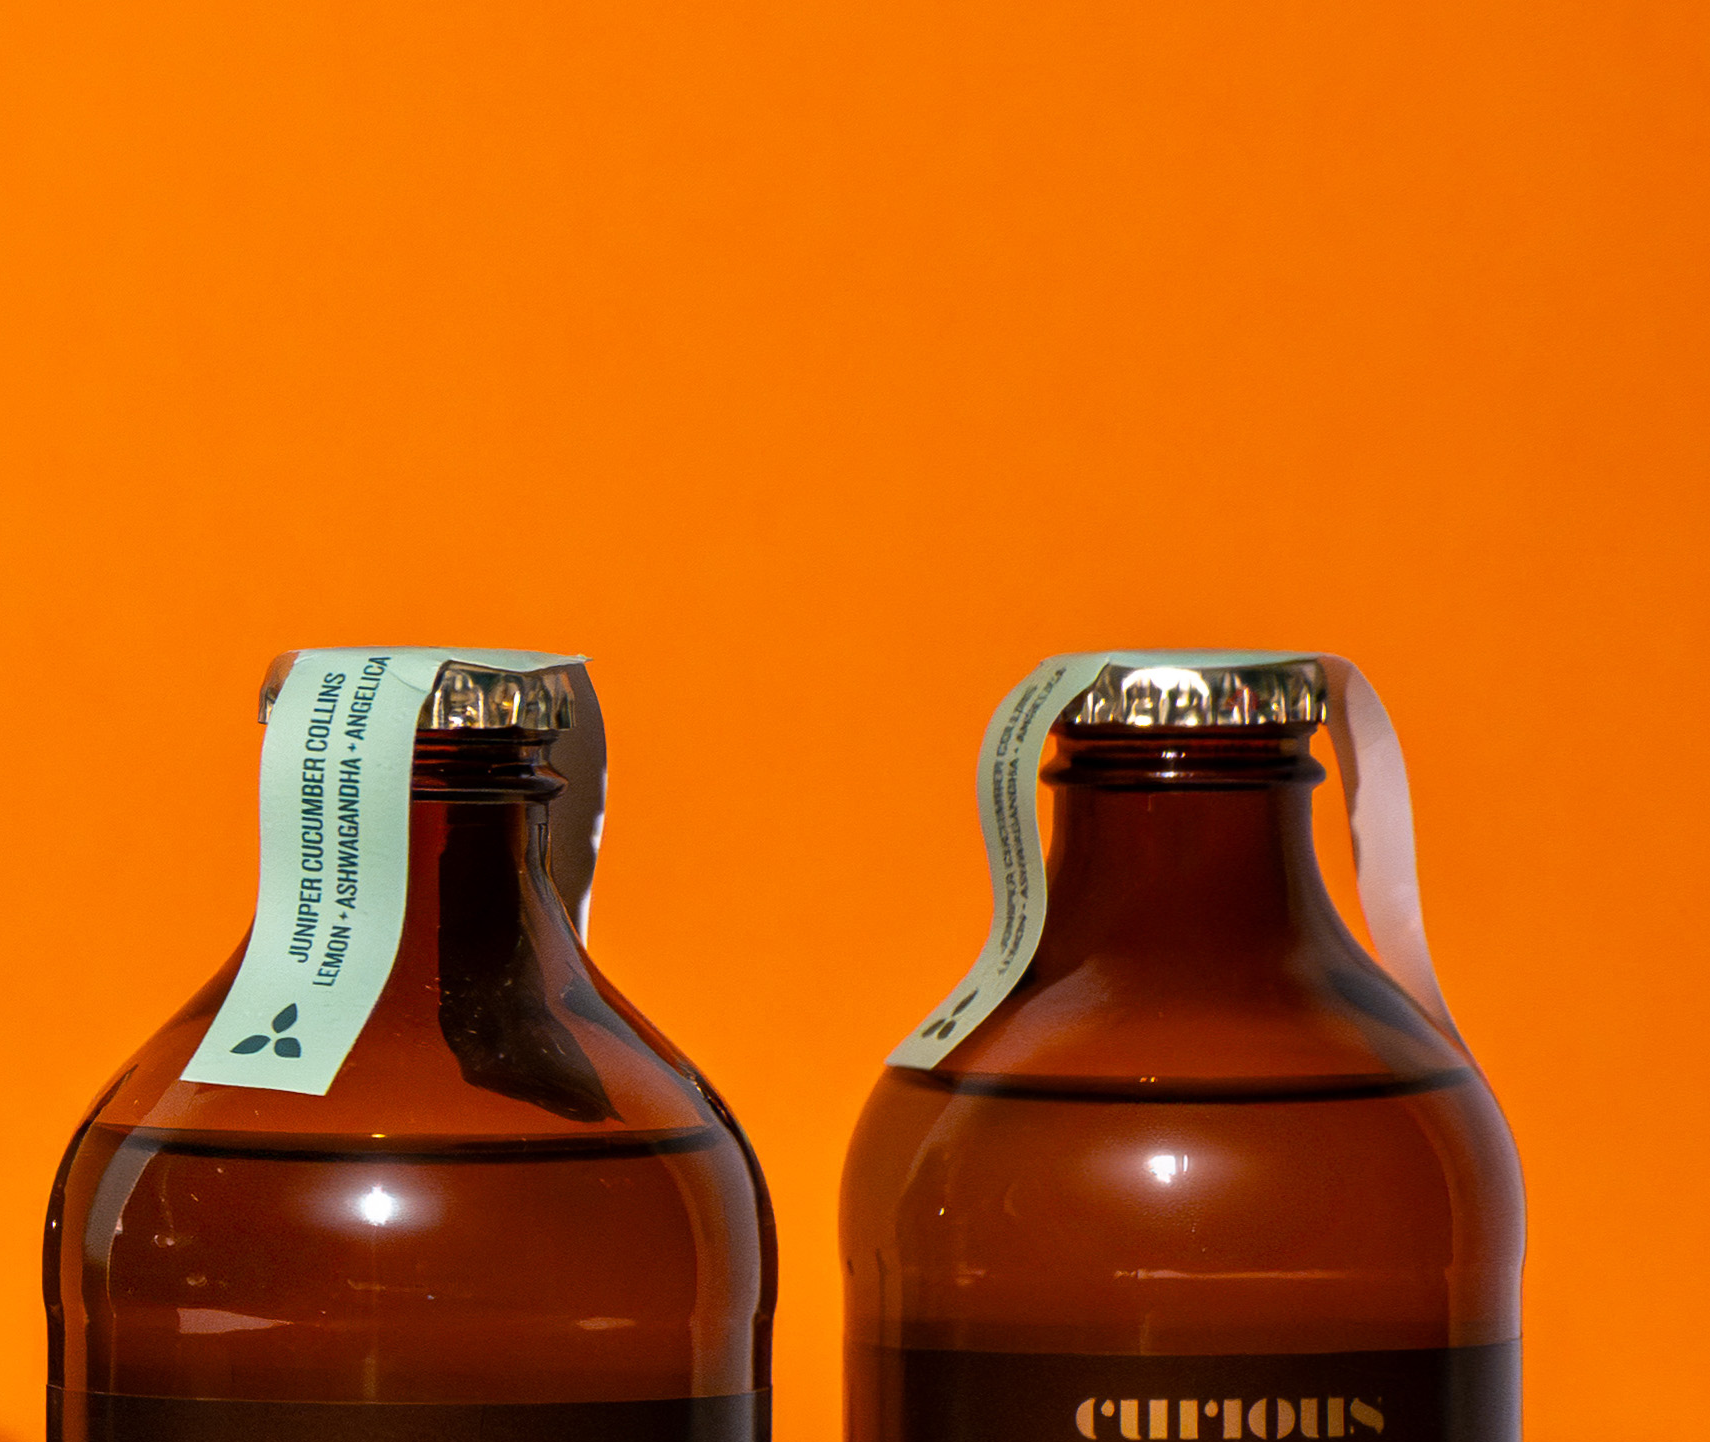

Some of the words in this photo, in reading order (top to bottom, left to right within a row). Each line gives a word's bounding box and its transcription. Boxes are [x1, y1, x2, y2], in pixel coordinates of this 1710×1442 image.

[306, 671, 347, 752] COLLINS
[344, 656, 392, 741] ANGELICA
[301, 757, 326, 873] CUCUMBER
[336, 757, 363, 910] ASHWAGANDHA
[288, 878, 323, 963] JUNIPER
[313, 925, 352, 988] LEMON
[1075, 1396, 1385, 1442] curious
